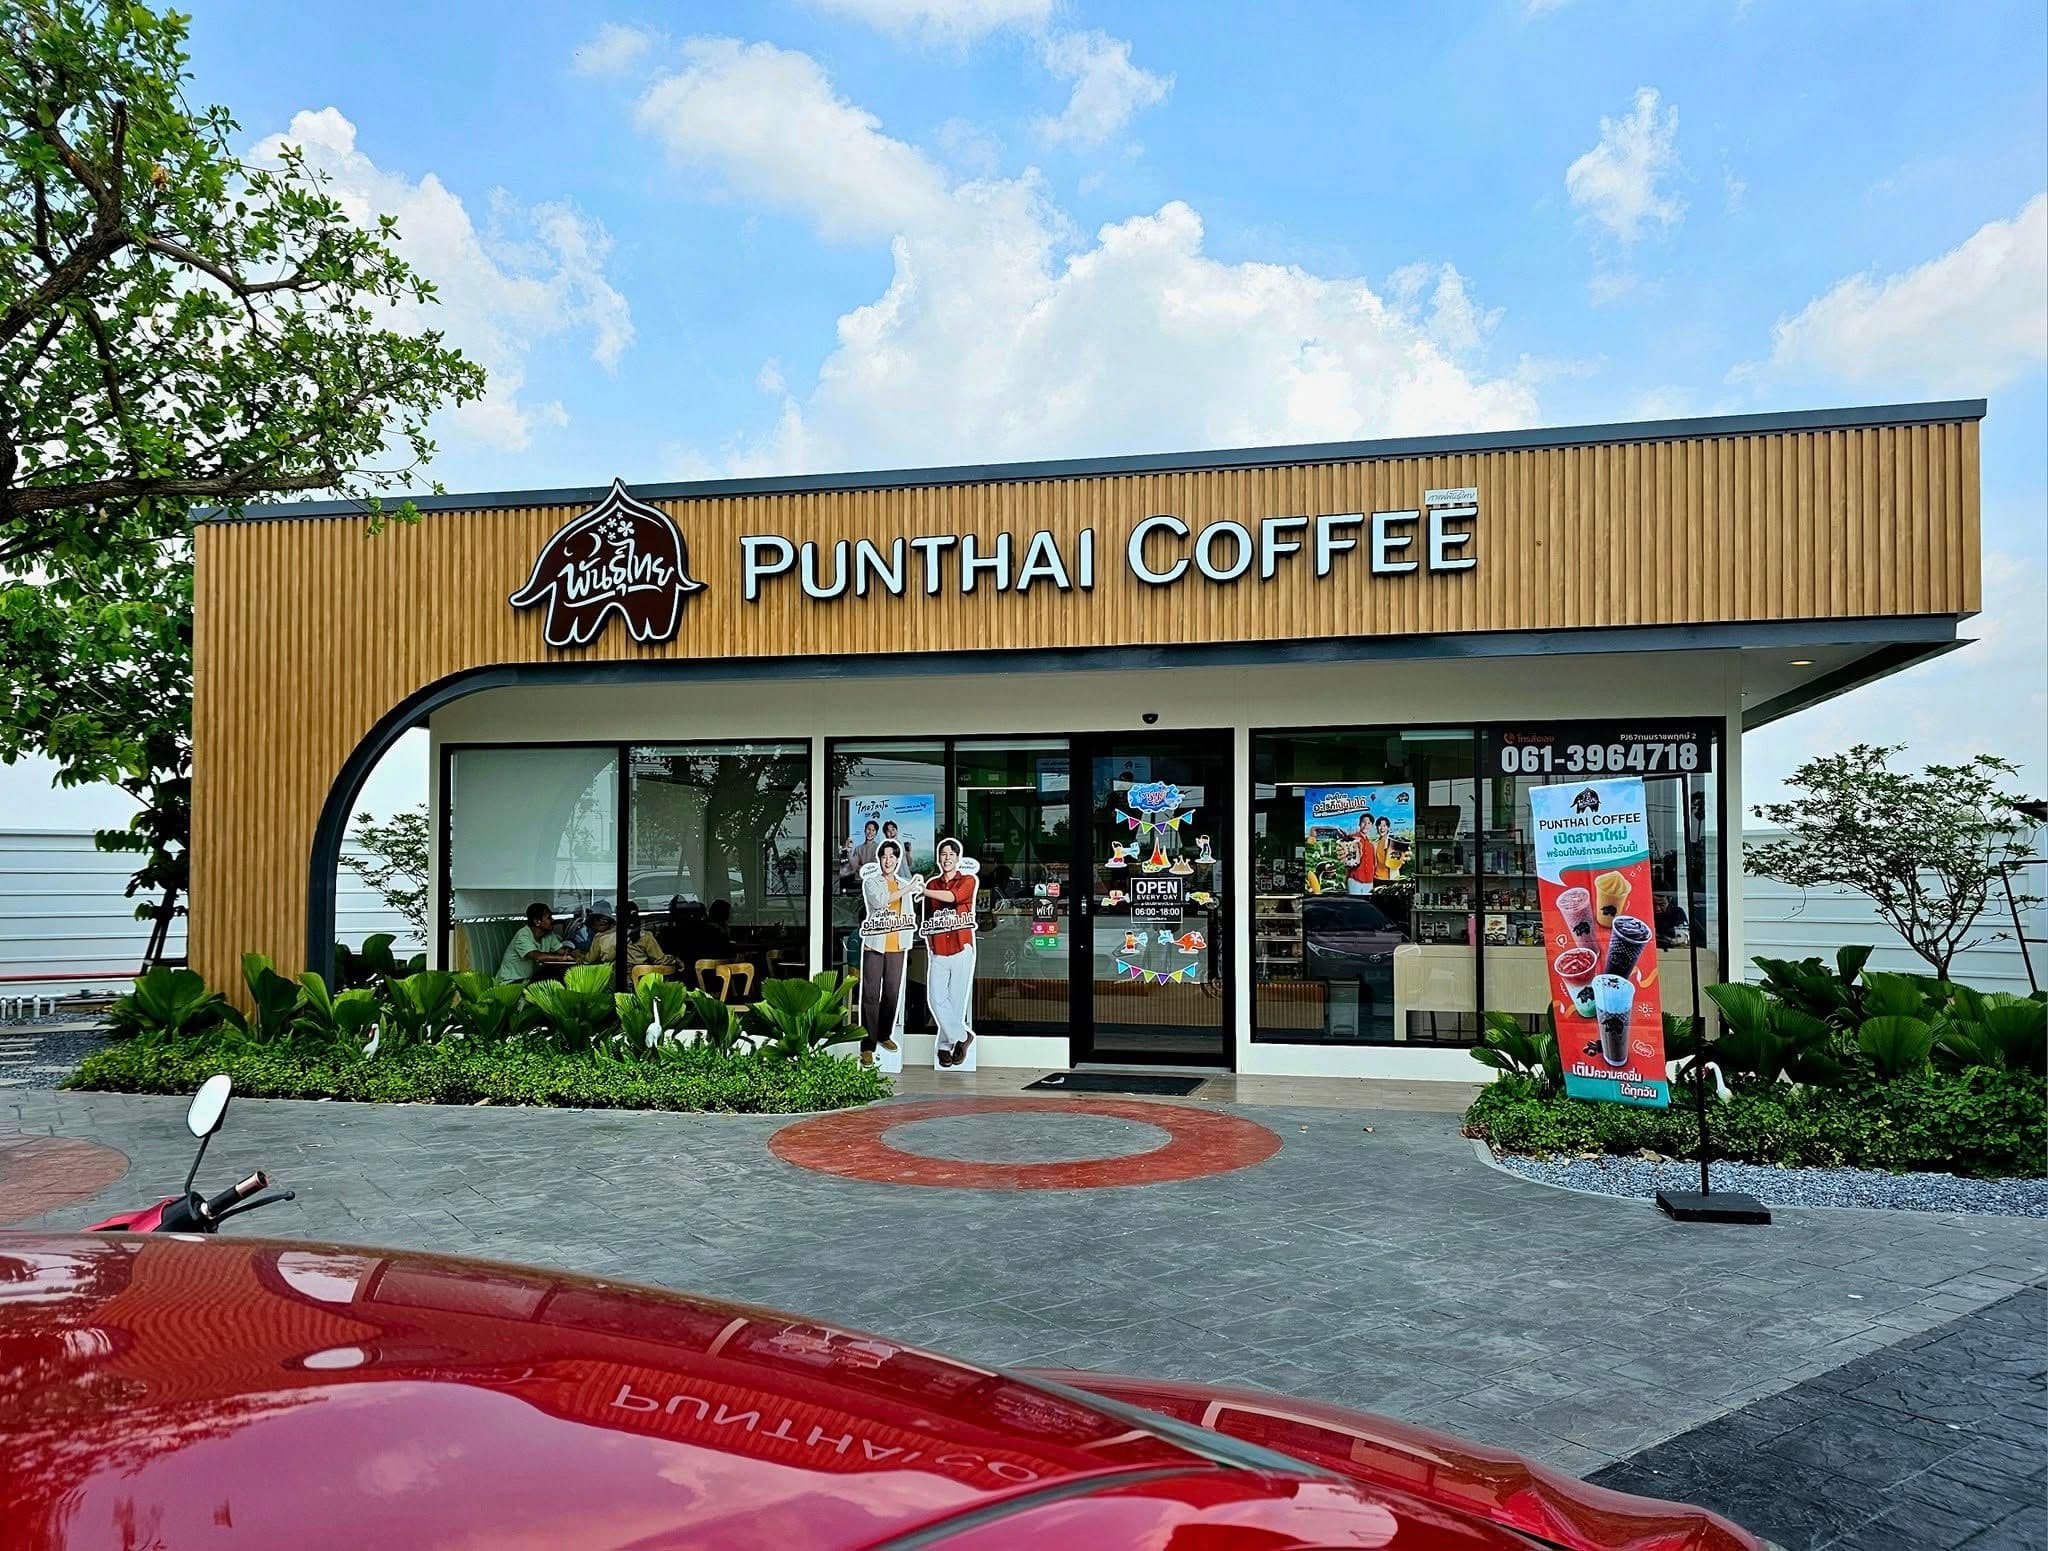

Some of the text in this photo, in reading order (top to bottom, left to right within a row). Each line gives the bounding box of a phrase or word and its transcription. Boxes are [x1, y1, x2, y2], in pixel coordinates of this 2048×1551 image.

[740, 507, 1478, 602] PUNTHAI COFFEE
[557, 538, 674, 599] พันธุ์ไทย
[1501, 743, 1698, 772] 061-3964718
[1539, 813, 1641, 830] PUNTHAI COFFEE
[1553, 826, 1628, 845] เปิดสาขาใหม่
[1136, 881, 1178, 894] OPEN
[1571, 1061, 1642, 1082] เติมความสดชื่น
[1620, 1082, 1657, 1100] ได้ทุกวัน
